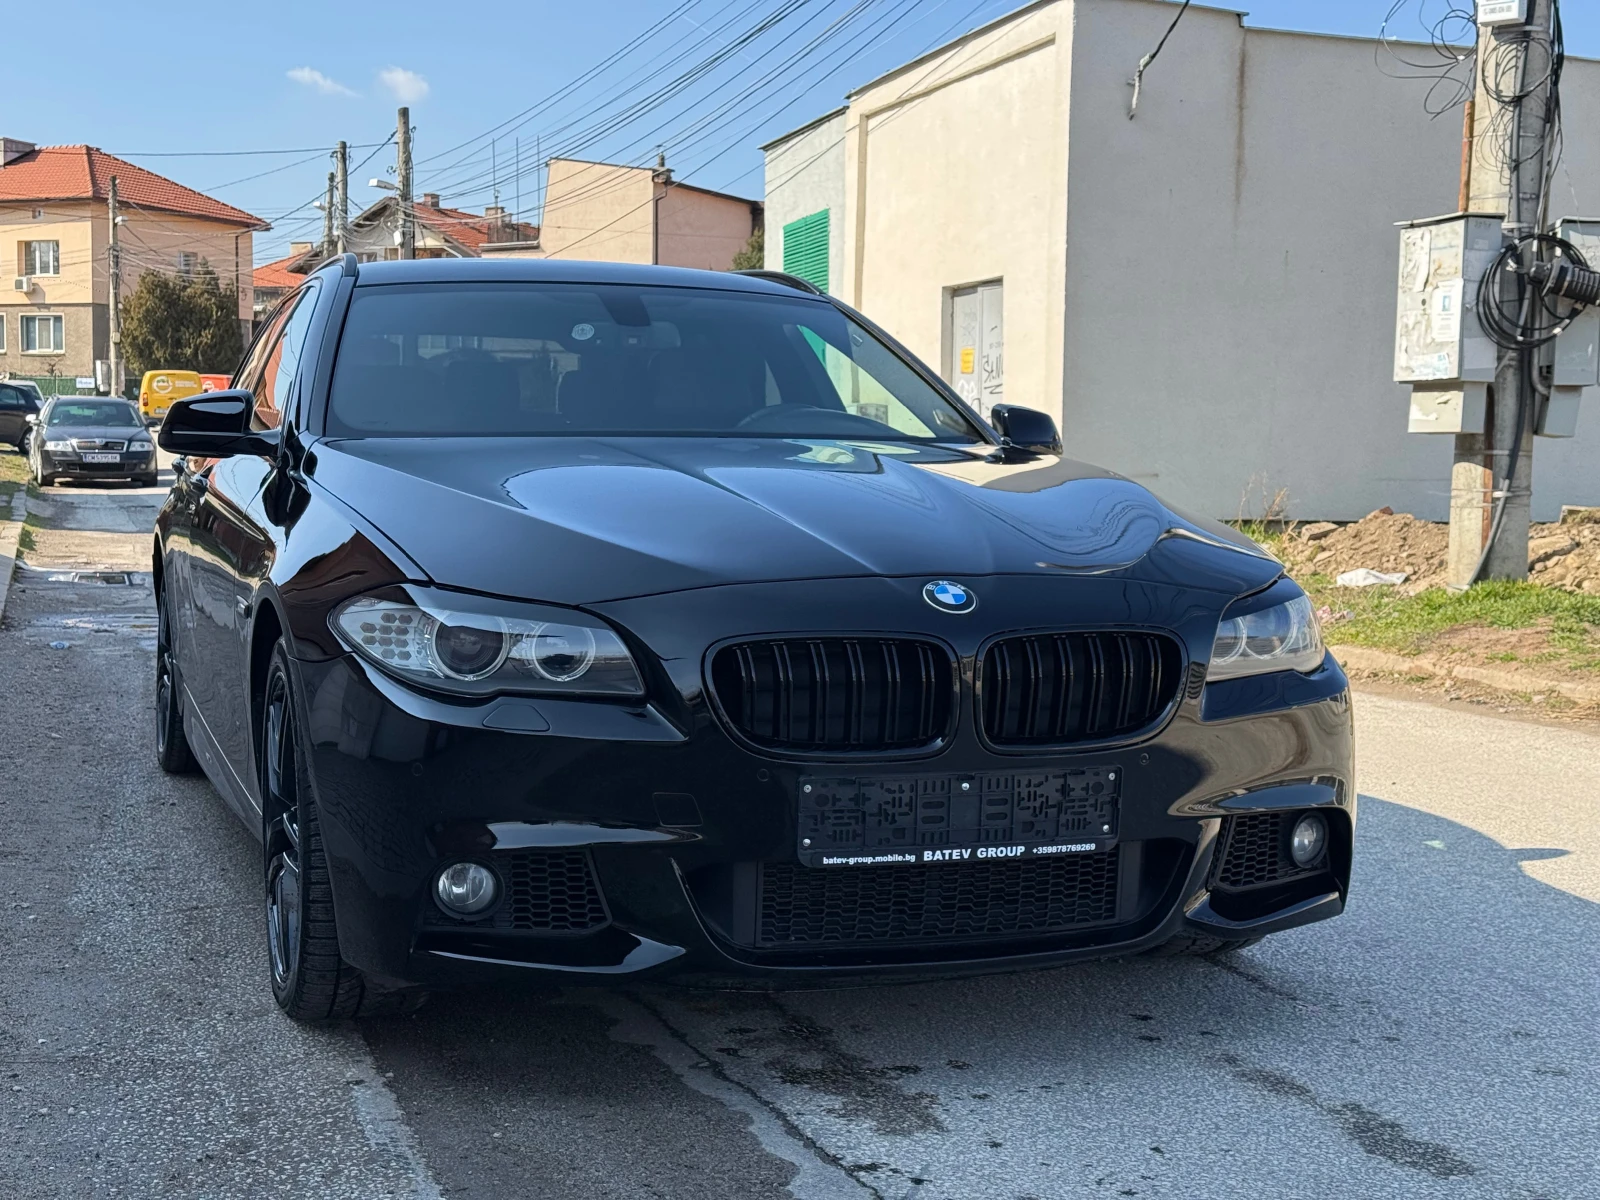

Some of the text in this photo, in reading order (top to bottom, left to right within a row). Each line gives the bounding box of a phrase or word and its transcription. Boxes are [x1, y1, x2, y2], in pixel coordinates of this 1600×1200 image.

[822, 843, 1096, 865] batev-group.mobile.bg BATEV GROUP +359878769269
